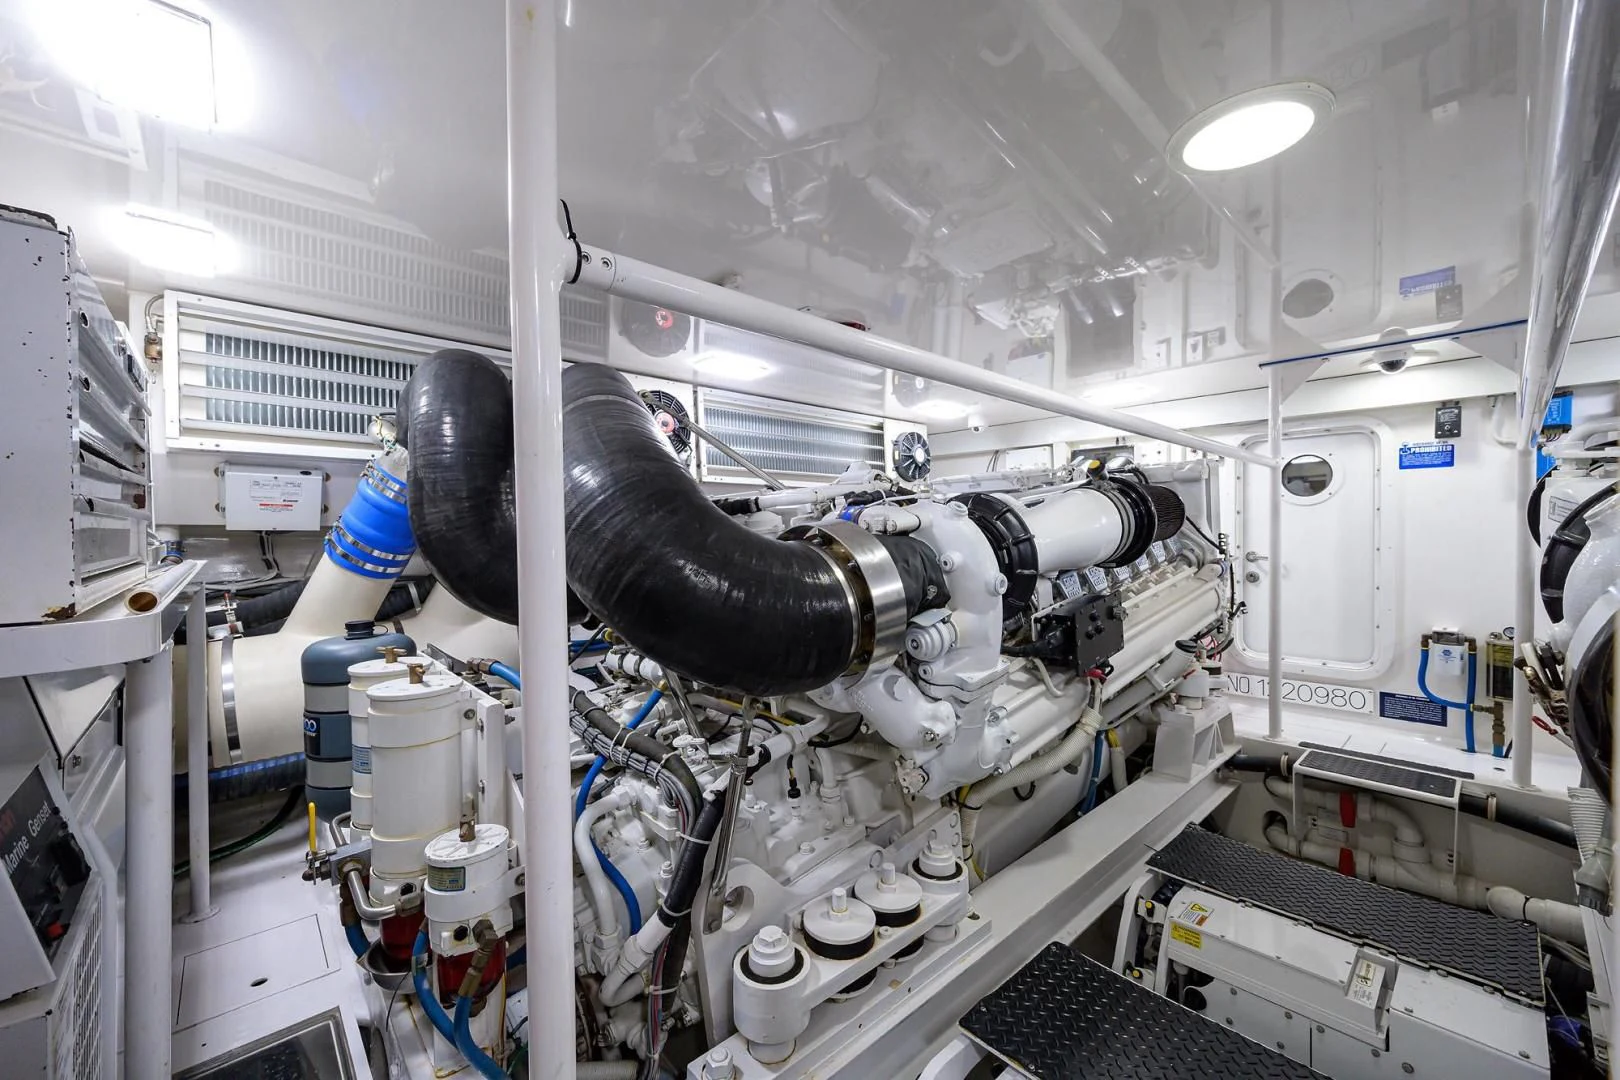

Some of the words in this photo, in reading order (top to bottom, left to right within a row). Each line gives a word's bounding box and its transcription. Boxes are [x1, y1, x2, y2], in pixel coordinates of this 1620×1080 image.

[1257, 679, 1366, 710] 120980
[5, 835, 30, 874] Marine
[28, 800, 52, 837] Genset
